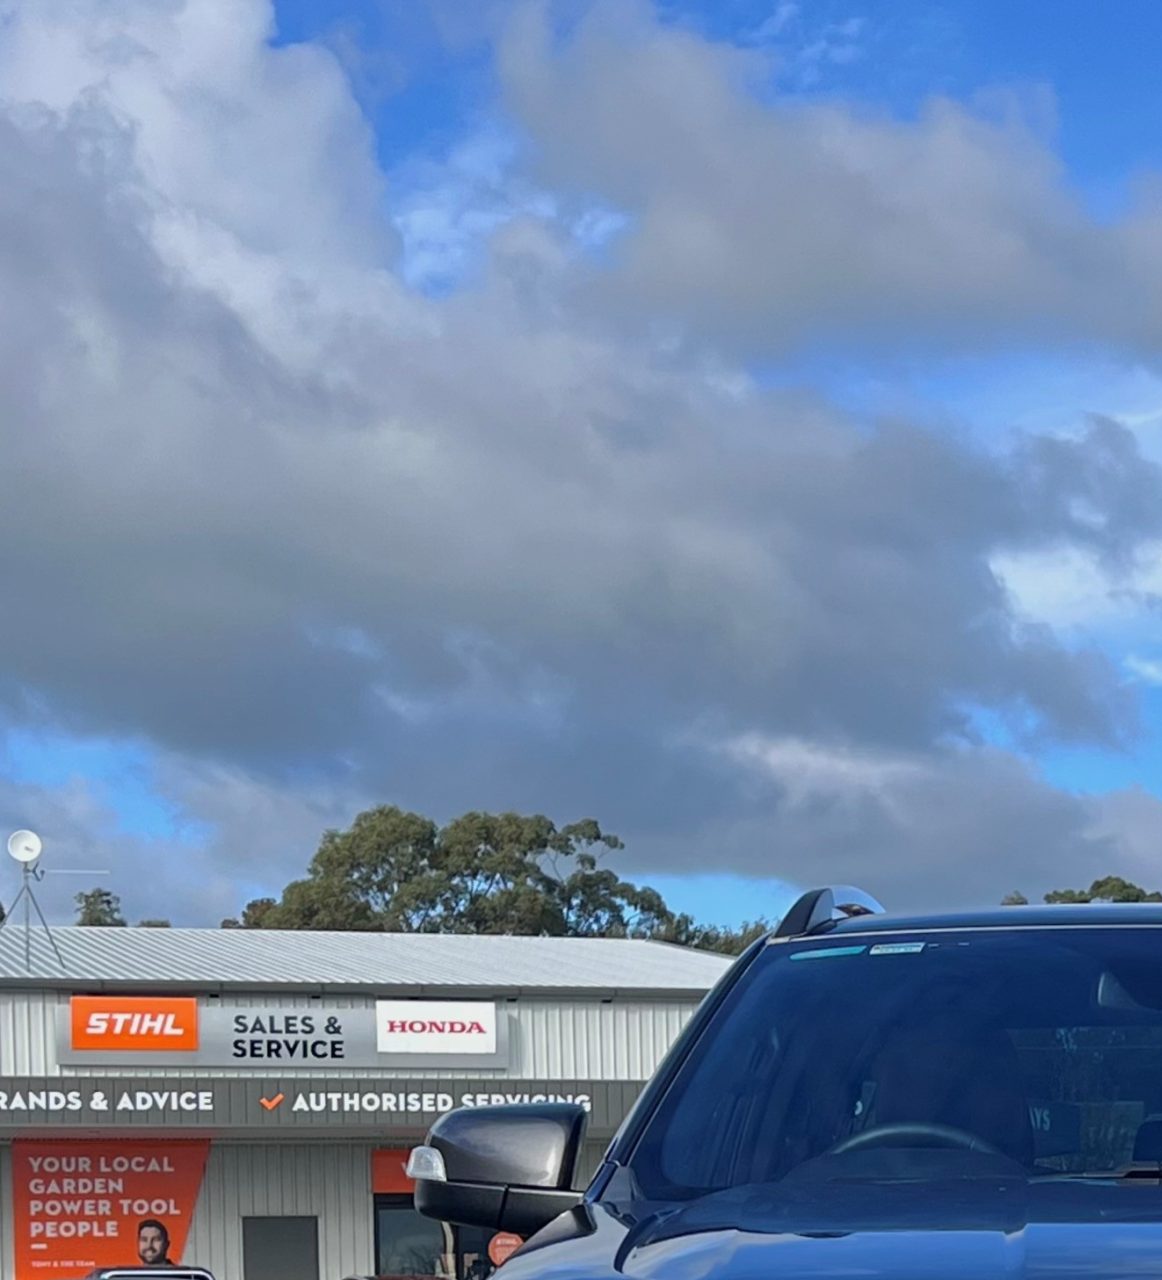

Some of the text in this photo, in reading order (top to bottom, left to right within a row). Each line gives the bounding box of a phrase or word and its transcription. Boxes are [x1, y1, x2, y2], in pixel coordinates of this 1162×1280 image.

[86, 1012, 184, 1035] STIHL
[233, 1015, 343, 1035] SALES &
[387, 1020, 486, 1033] HONDA
[232, 1039, 345, 1058] SERVICE
[89, 1091, 109, 1110] &
[116, 1091, 214, 1110] ADVICE
[292, 1092, 454, 1112] AUTHORISED
[28, 1156, 175, 1173] YOUR LOCAL
[29, 1178, 123, 1194] GARDEN
[30, 1199, 181, 1216] POWER TOOL
[30, 1221, 119, 1237] PEOPLE
